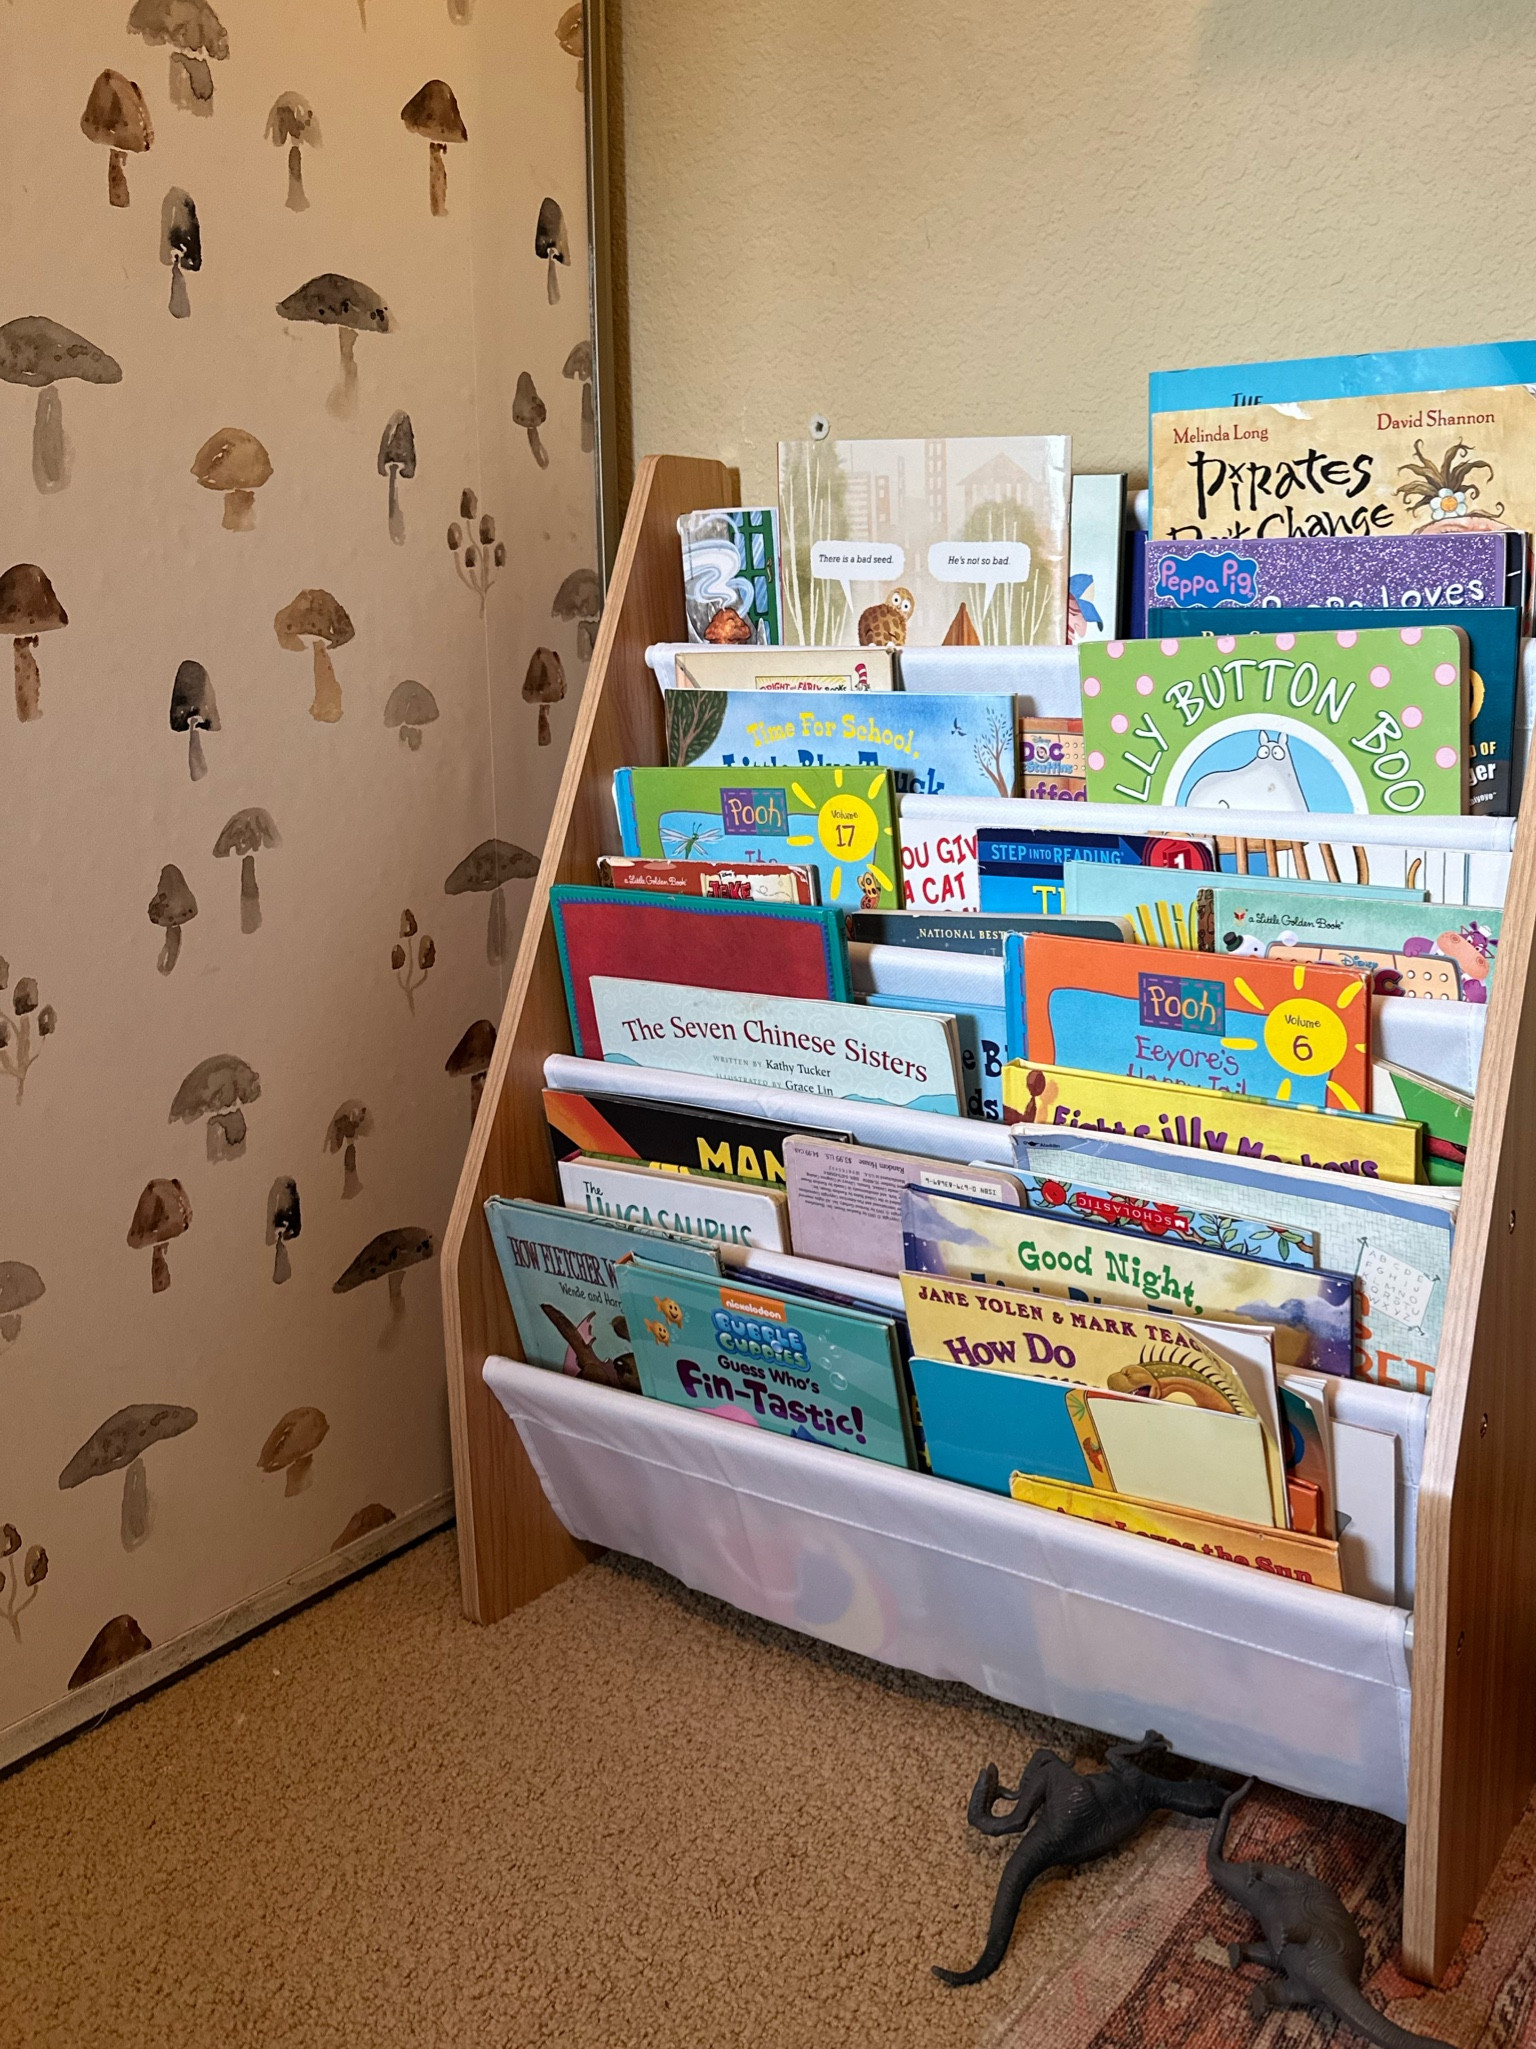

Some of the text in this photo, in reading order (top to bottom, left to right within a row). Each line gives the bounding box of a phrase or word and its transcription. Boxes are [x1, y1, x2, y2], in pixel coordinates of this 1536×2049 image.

[1377, 409, 1495, 431] David Shannon
[1173, 424, 1269, 444] Melinda Long
[818, 554, 842, 564] There
[842, 555, 849, 564] is
[856, 554, 872, 564] bad
[873, 555, 894, 564] seed.
[948, 556, 965, 565] He's
[966, 557, 980, 565] not
[1161, 559, 1252, 600] Peppa Pig
[1164, 658, 1357, 726] BUTTON
[746, 721, 795, 748] Time
[799, 712, 836, 736] For
[1479, 741, 1497, 756] OF
[728, 797, 782, 827] Pooh
[831, 809, 859, 819] Volume
[835, 825, 856, 848] 17
[991, 843, 1121, 864] STEP INTO READING
[1174, 852, 1186, 869] 1
[629, 875, 646, 886] Little
[646, 875, 669, 886] Golden
[669, 876, 687, 887] Book
[922, 871, 966, 905] CAT
[1255, 912, 1280, 925] Little
[1281, 914, 1315, 928] Golden
[1316, 916, 1342, 930] Book
[919, 928, 976, 940] NATIONAL
[1148, 985, 1217, 1025] Pooh
[1284, 1014, 1322, 1029] Volume
[621, 1016, 928, 1083] The Seven Chinese Sisters
[1134, 1035, 1240, 1076] Eeyore's
[1293, 1034, 1313, 1061] 6
[713, 1055, 749, 1067] WRITTEN
[765, 1059, 795, 1075] Kathy
[797, 1063, 831, 1078] Tucker
[772, 1081, 782, 1089] BY
[785, 1080, 814, 1093] Grace
[817, 1085, 834, 1097] Lin
[858, 1160, 878, 1170] House
[879, 1163, 905, 1175] Random
[583, 1181, 603, 1196] The
[980, 1187, 996, 1196] ISBN
[1078, 1196, 1172, 1226] SCHOLASTIC
[507, 1235, 540, 1271] HOW
[537, 1243, 608, 1288] FLETCHER
[1017, 1241, 1204, 1316] Good Night,
[588, 1291, 603, 1304] and
[725, 1298, 782, 1320] nickelodeon
[918, 1286, 969, 1307] JANE
[975, 1295, 1044, 1321] YOLEN
[1053, 1311, 1064, 1324] &
[1070, 1312, 1137, 1338] MARK
[714, 1311, 802, 1351] BUBBLE
[717, 1355, 820, 1394] Guess Who's
[676, 1358, 867, 1445] Fin-Tastic!
